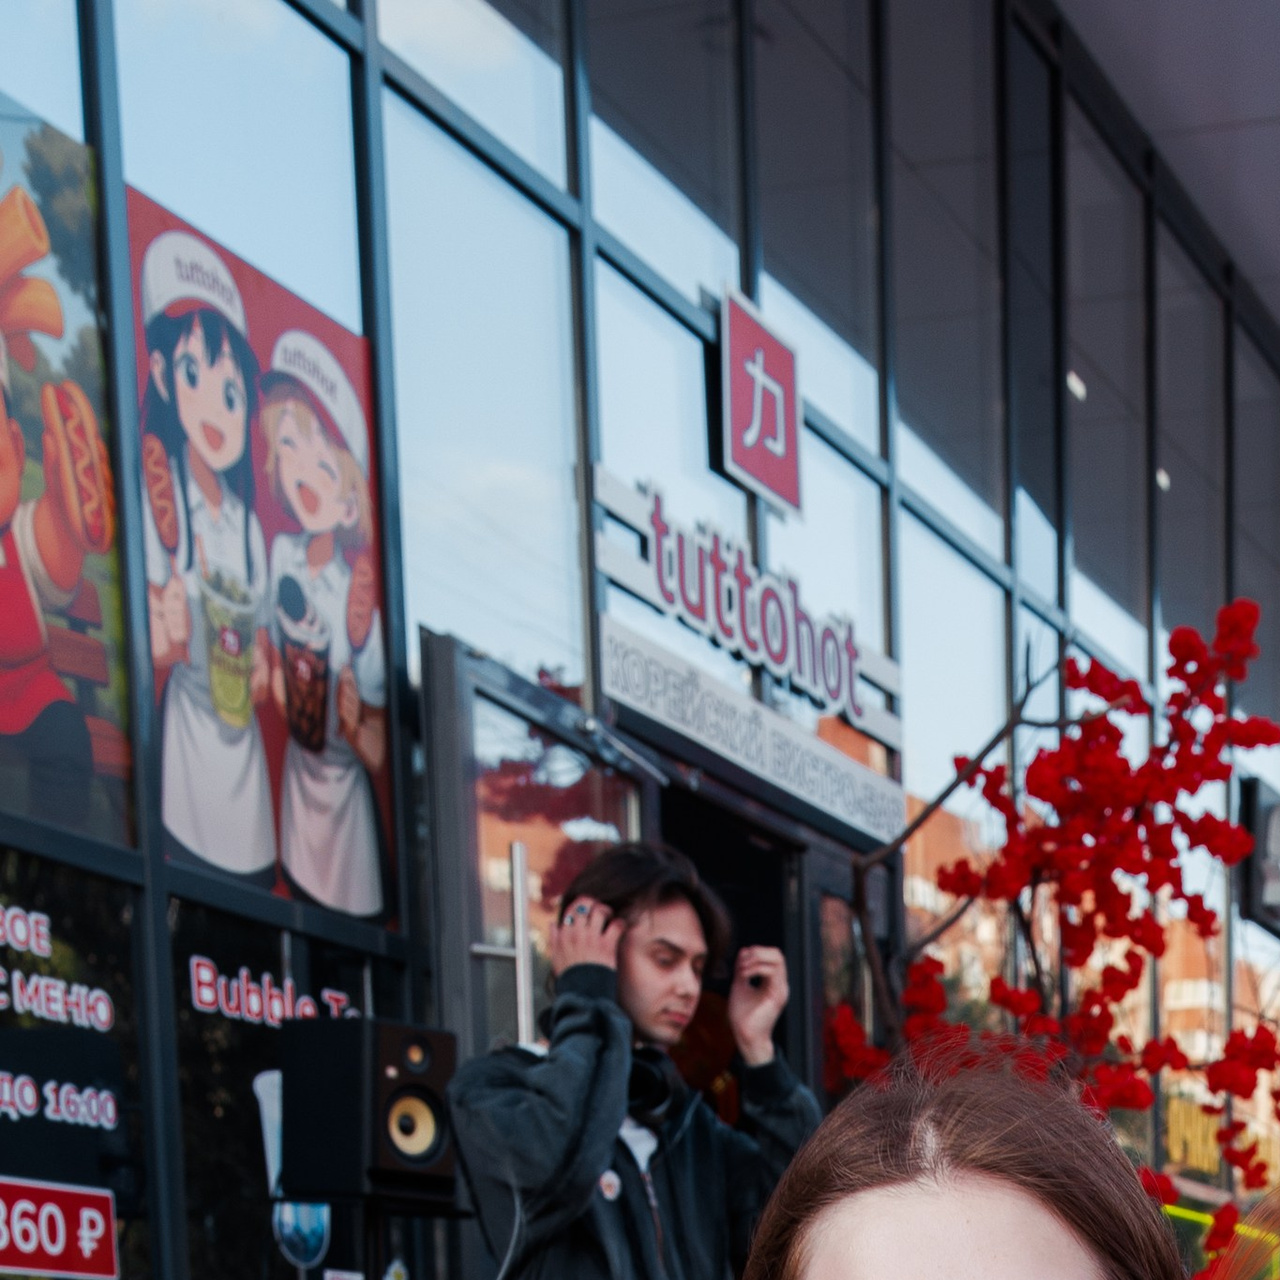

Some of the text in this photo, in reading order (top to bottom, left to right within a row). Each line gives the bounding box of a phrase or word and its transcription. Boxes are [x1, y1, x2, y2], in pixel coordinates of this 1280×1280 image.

[650, 493, 863, 718] tuttohot
[11, 968, 115, 1033] МЕНЮ
[189, 954, 319, 1030] Bubble
[42, 1079, 119, 1131] 16:00
